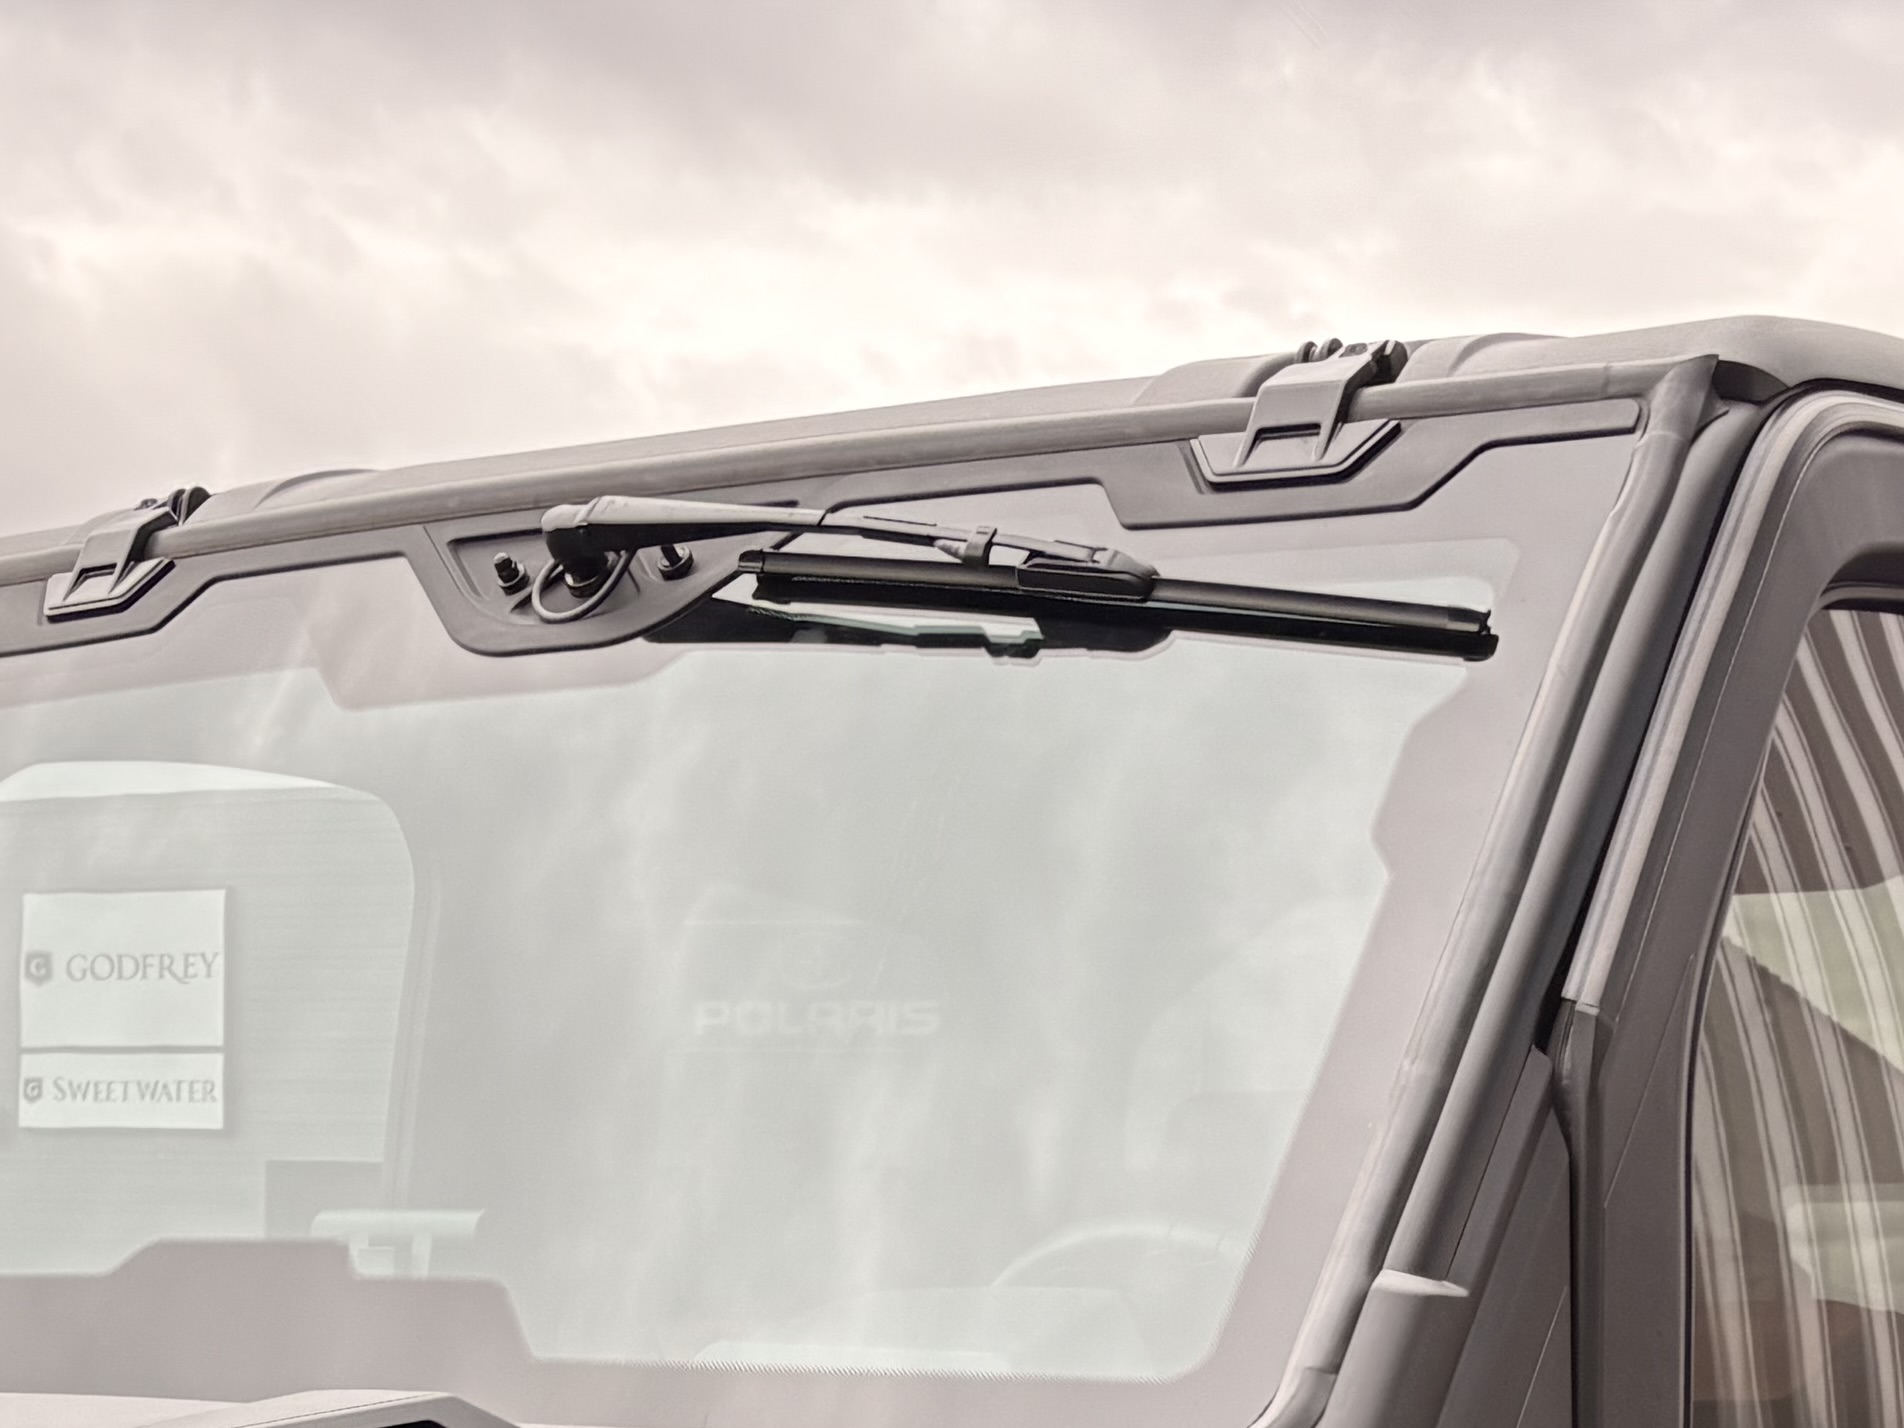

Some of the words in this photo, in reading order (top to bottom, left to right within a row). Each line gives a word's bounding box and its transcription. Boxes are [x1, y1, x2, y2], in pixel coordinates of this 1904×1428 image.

[65, 952, 219, 985] GODFREY
[695, 1001, 940, 1036] POLARIS
[52, 1077, 218, 1103] SWEETWATER
